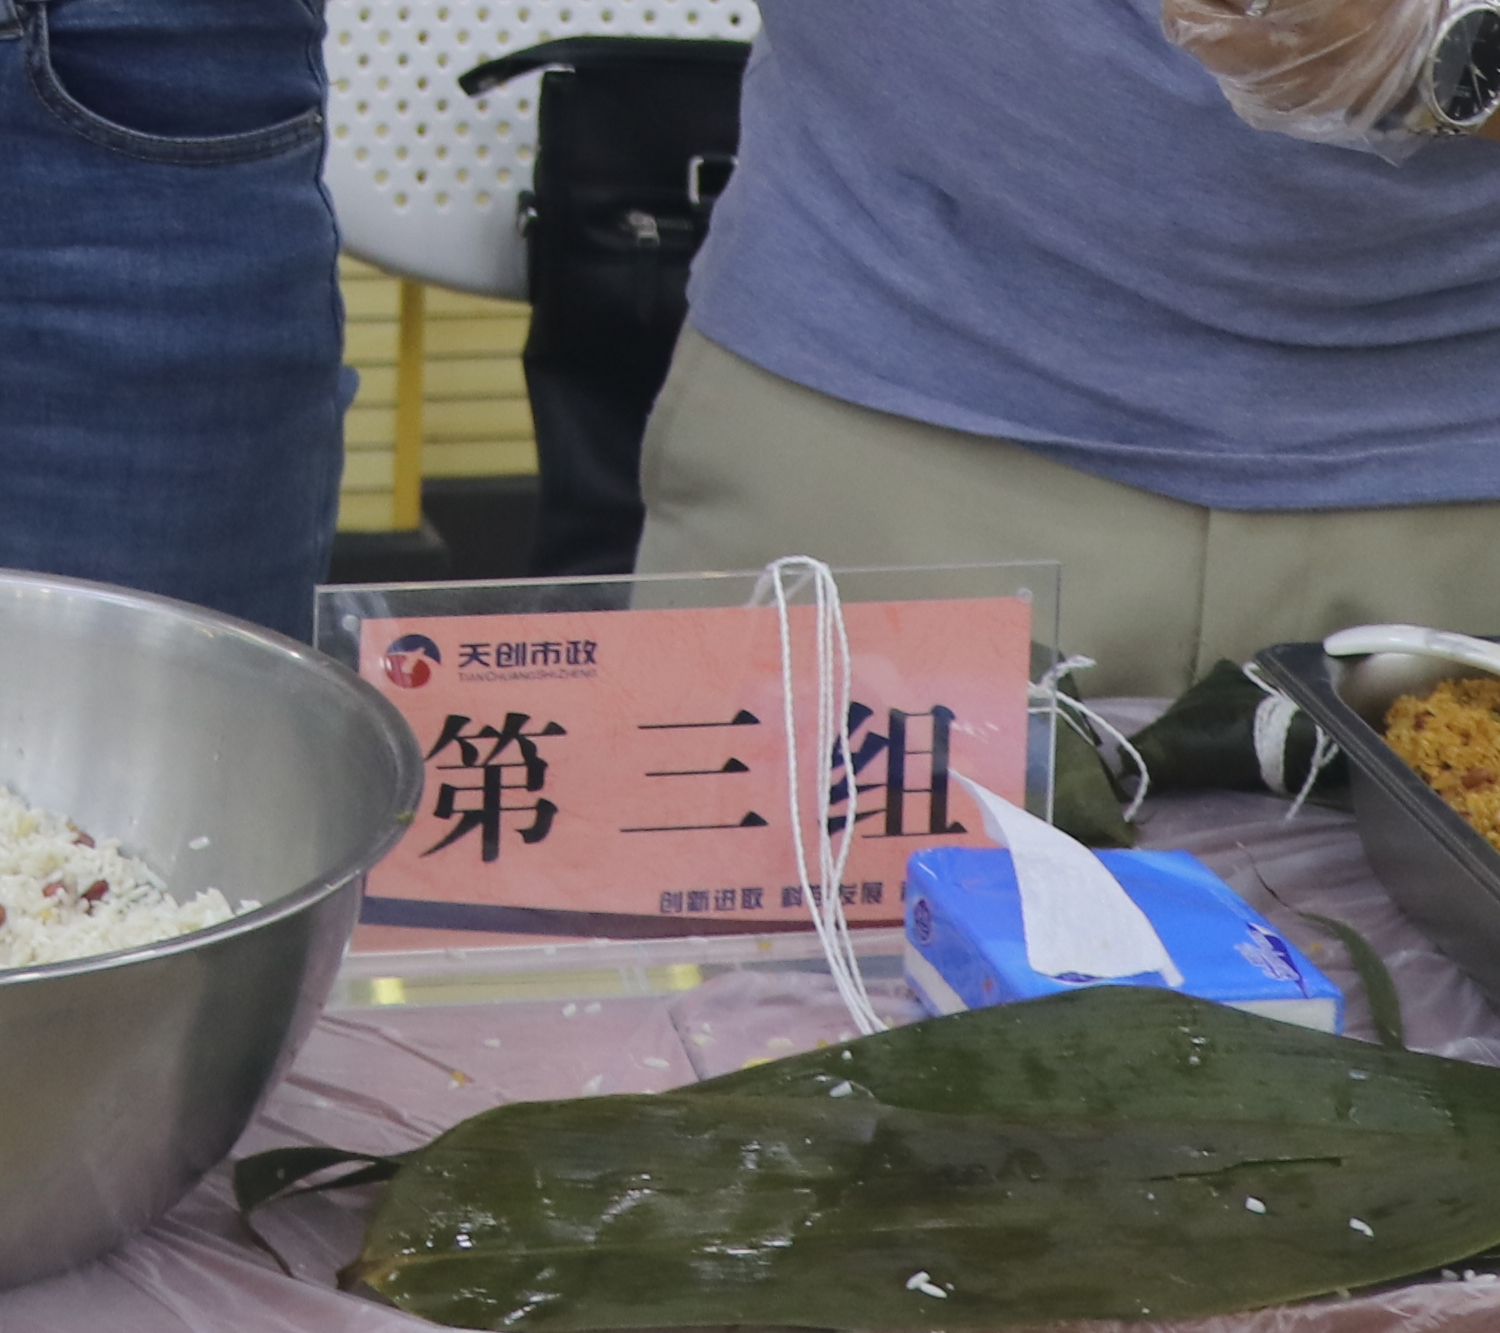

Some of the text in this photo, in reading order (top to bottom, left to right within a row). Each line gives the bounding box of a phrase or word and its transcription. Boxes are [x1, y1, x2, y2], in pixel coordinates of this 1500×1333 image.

[458, 639, 598, 669] 天创市政
[420, 700, 968, 862] 第三组
[659, 887, 763, 914] 创新进取
